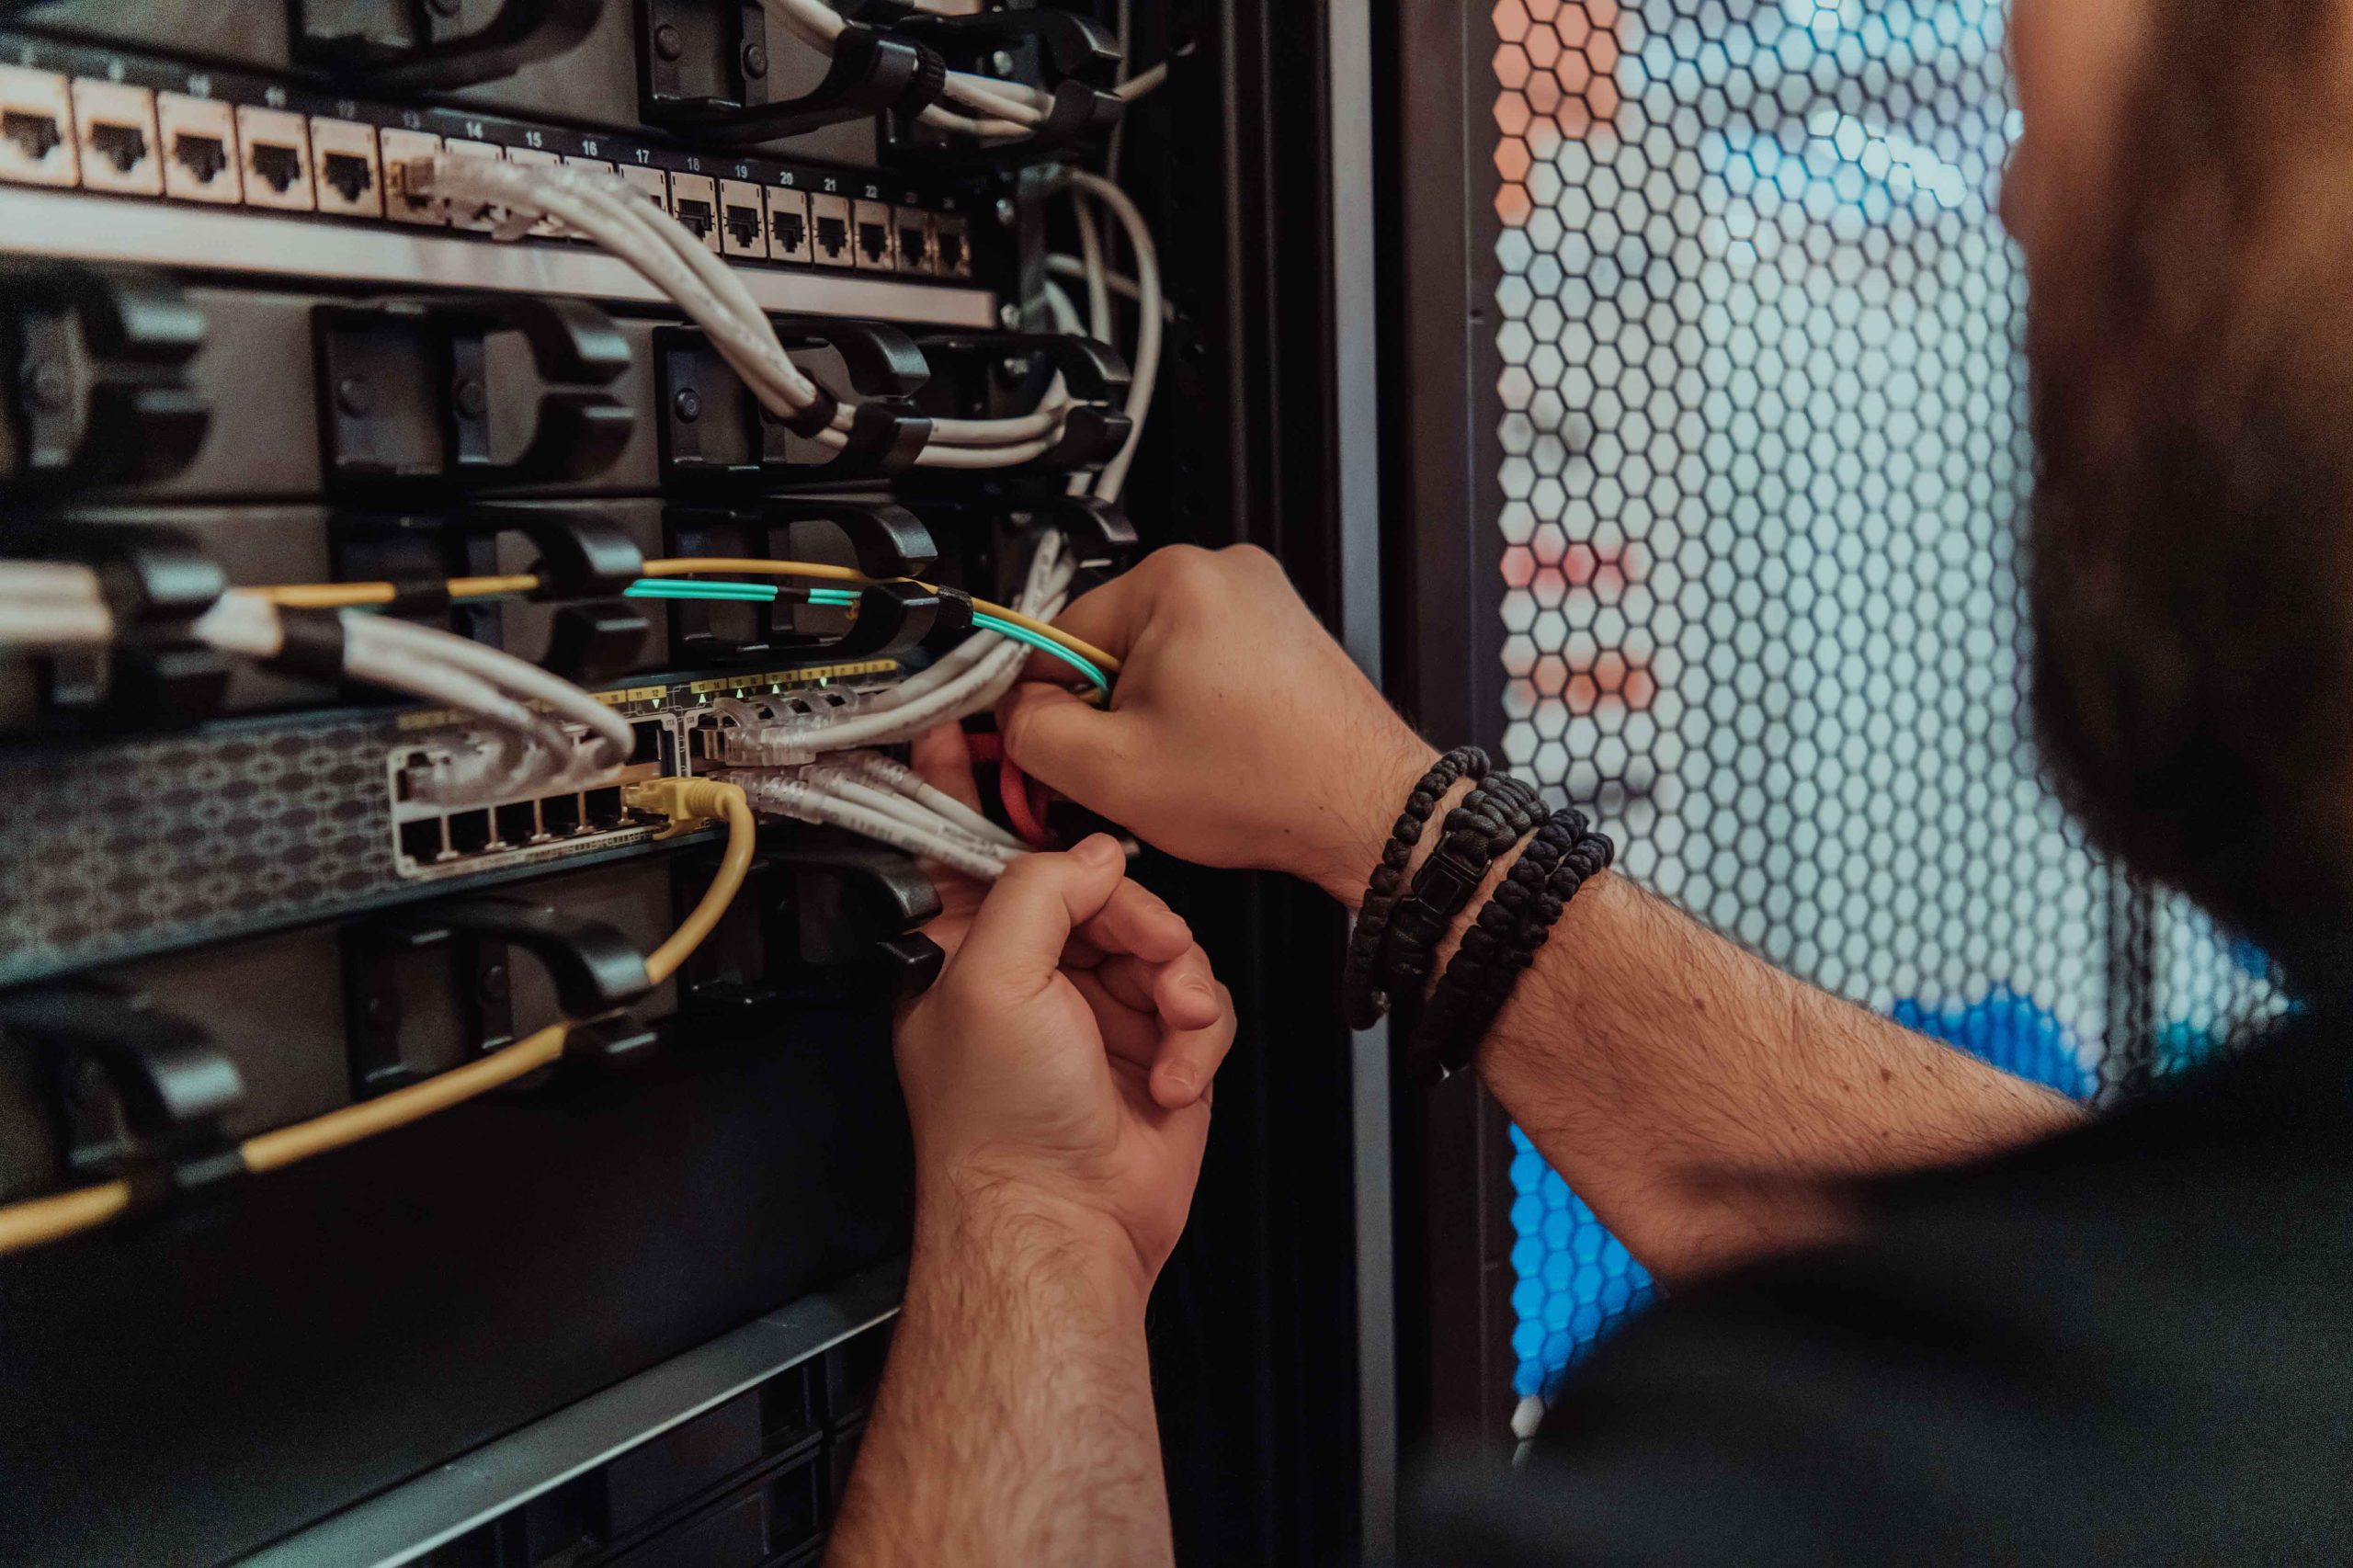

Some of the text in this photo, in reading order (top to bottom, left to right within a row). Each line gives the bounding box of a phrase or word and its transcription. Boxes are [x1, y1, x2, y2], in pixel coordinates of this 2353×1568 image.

[465, 121, 483, 139] 14
[525, 131, 542, 148] 15
[582, 140, 597, 156] 16
[635, 148, 650, 164] 17
[687, 156, 700, 171] 18
[735, 165, 749, 179] 19
[780, 171, 793, 186] 20
[824, 178, 836, 192] 21
[652, 689, 660, 698] 12
